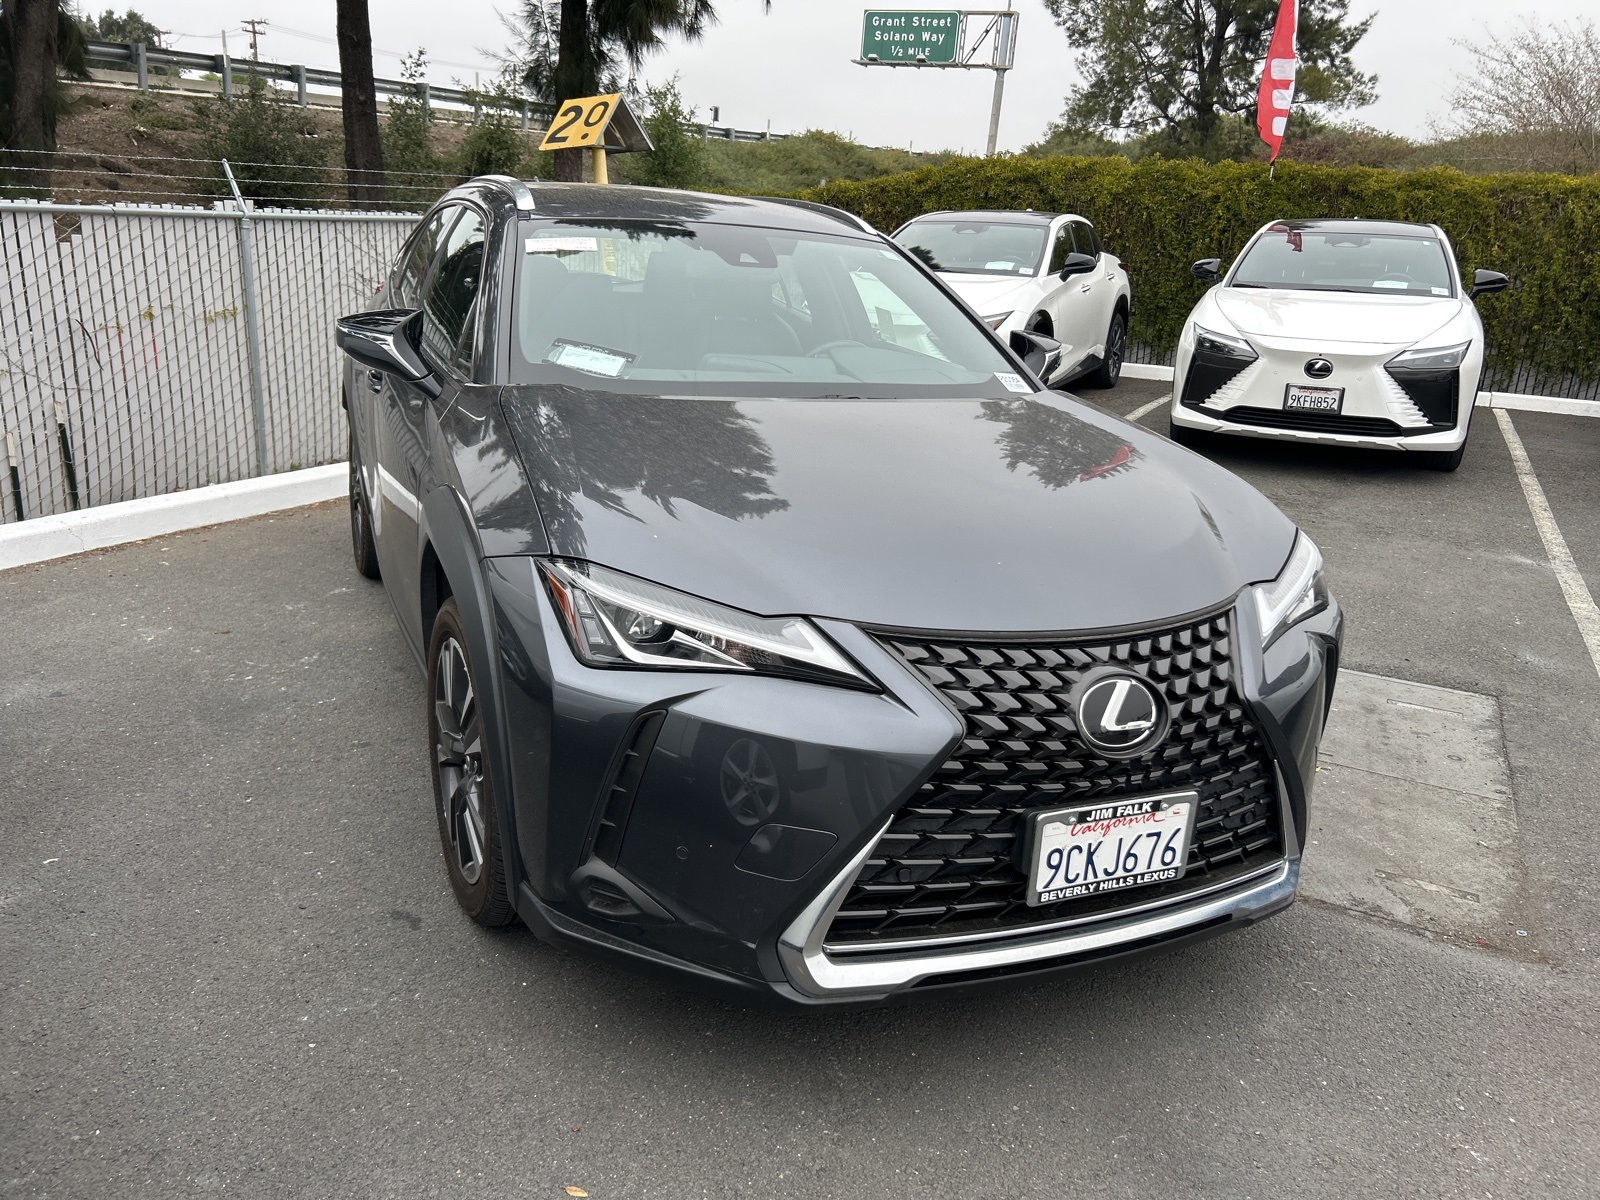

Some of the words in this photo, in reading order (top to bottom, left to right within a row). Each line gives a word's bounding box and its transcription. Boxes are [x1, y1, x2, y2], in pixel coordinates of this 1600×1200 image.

[872, 16, 905, 27] Grant
[912, 16, 951, 27] Street
[874, 31, 915, 42] Solano
[922, 31, 945, 45] Way
[908, 47, 931, 56] MILE
[1290, 394, 1337, 409] 9KFH852
[1086, 808, 1113, 822] JIM
[1116, 802, 1153, 817] FALK
[1070, 812, 1165, 837] California
[1042, 827, 1182, 889] 9CKJ676
[1040, 883, 1098, 902] BEVERLY
[1099, 876, 1135, 891] HILLS
[1136, 869, 1176, 884] LEXUS
